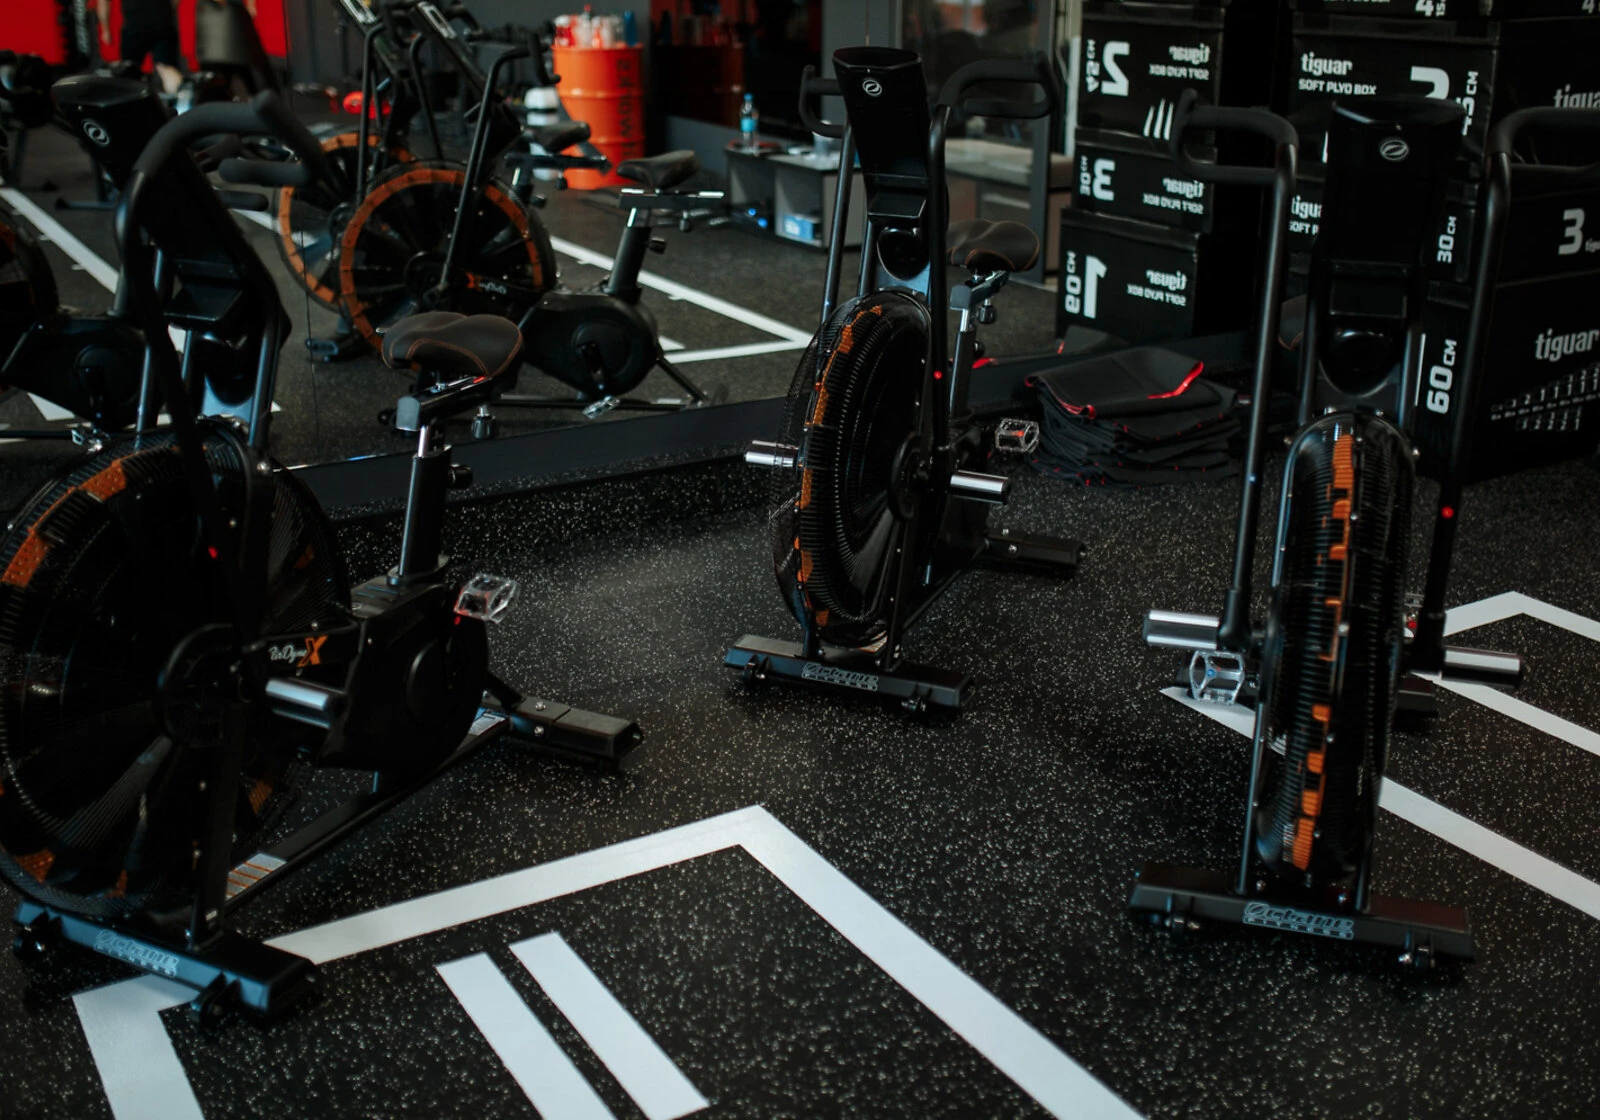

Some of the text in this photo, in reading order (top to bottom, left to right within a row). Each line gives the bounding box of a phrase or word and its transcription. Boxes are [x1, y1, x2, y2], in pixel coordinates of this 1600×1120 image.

[1301, 51, 1353, 77] tiguar
[1298, 78, 1379, 97] SOFT PLYO BOX
[1436, 215, 1457, 264] 30CM
[1558, 208, 1586, 255] 3
[1535, 328, 1600, 362] tiguar
[1427, 339, 1457, 414] 60CM
